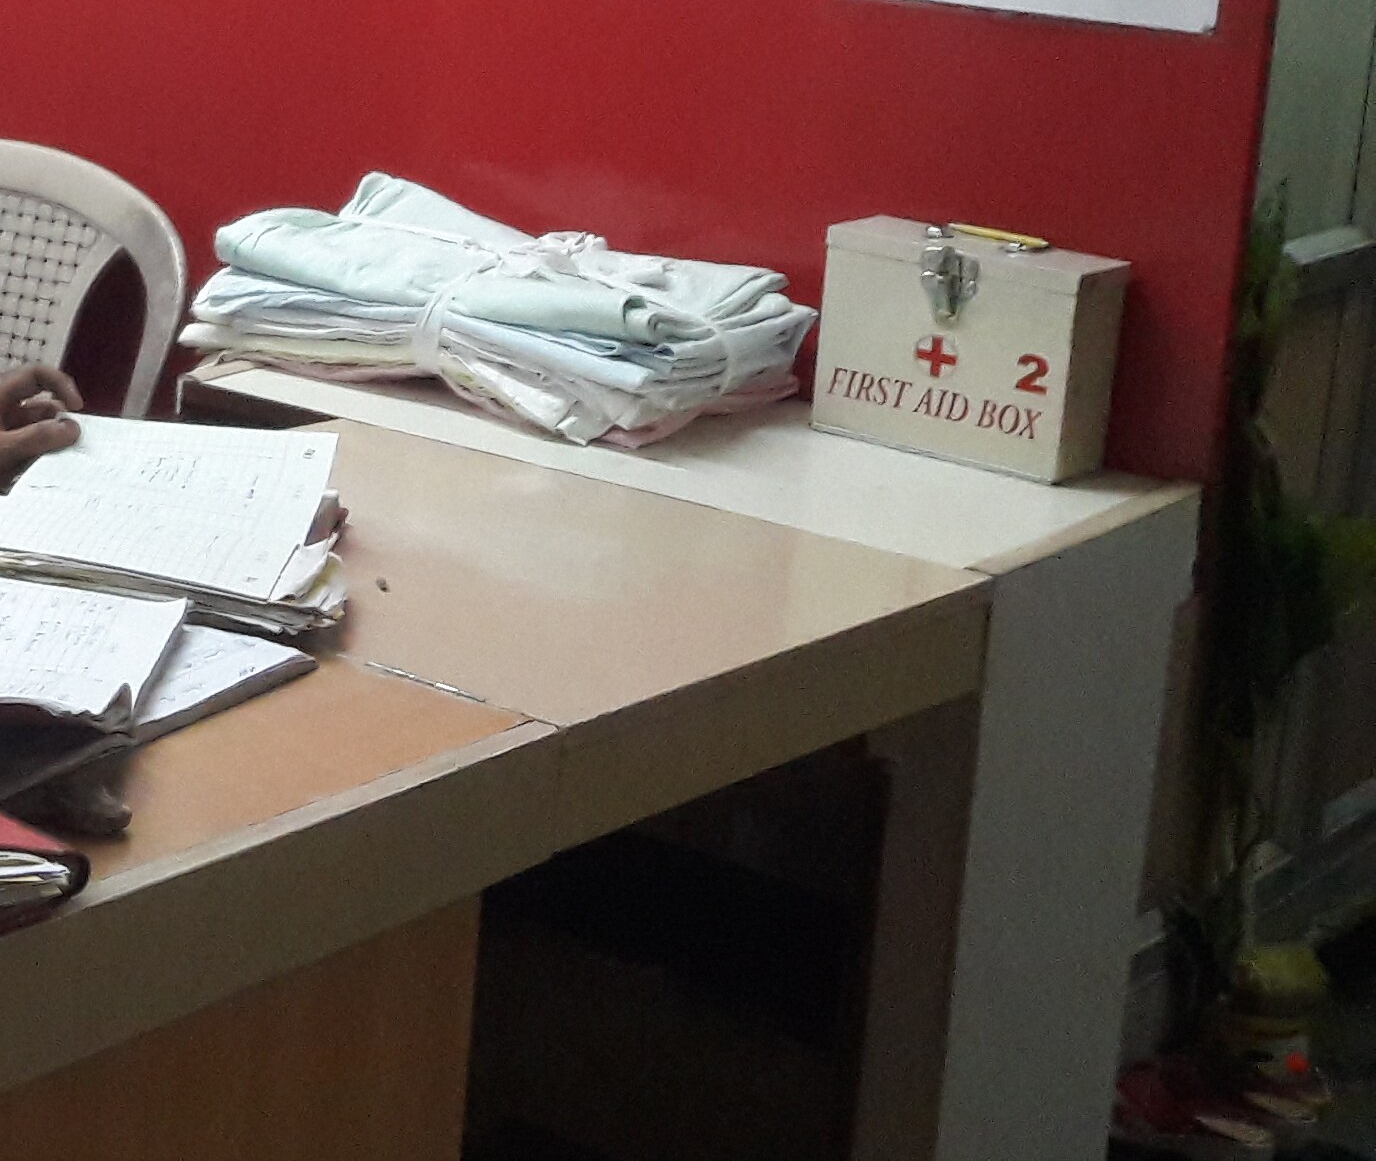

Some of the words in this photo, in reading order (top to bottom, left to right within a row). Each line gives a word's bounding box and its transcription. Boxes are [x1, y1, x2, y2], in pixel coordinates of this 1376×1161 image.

[828, 367, 913, 409] FIRST
[913, 387, 969, 423] AID
[976, 399, 1043, 440] BOX
[1015, 353, 1049, 396] 2
